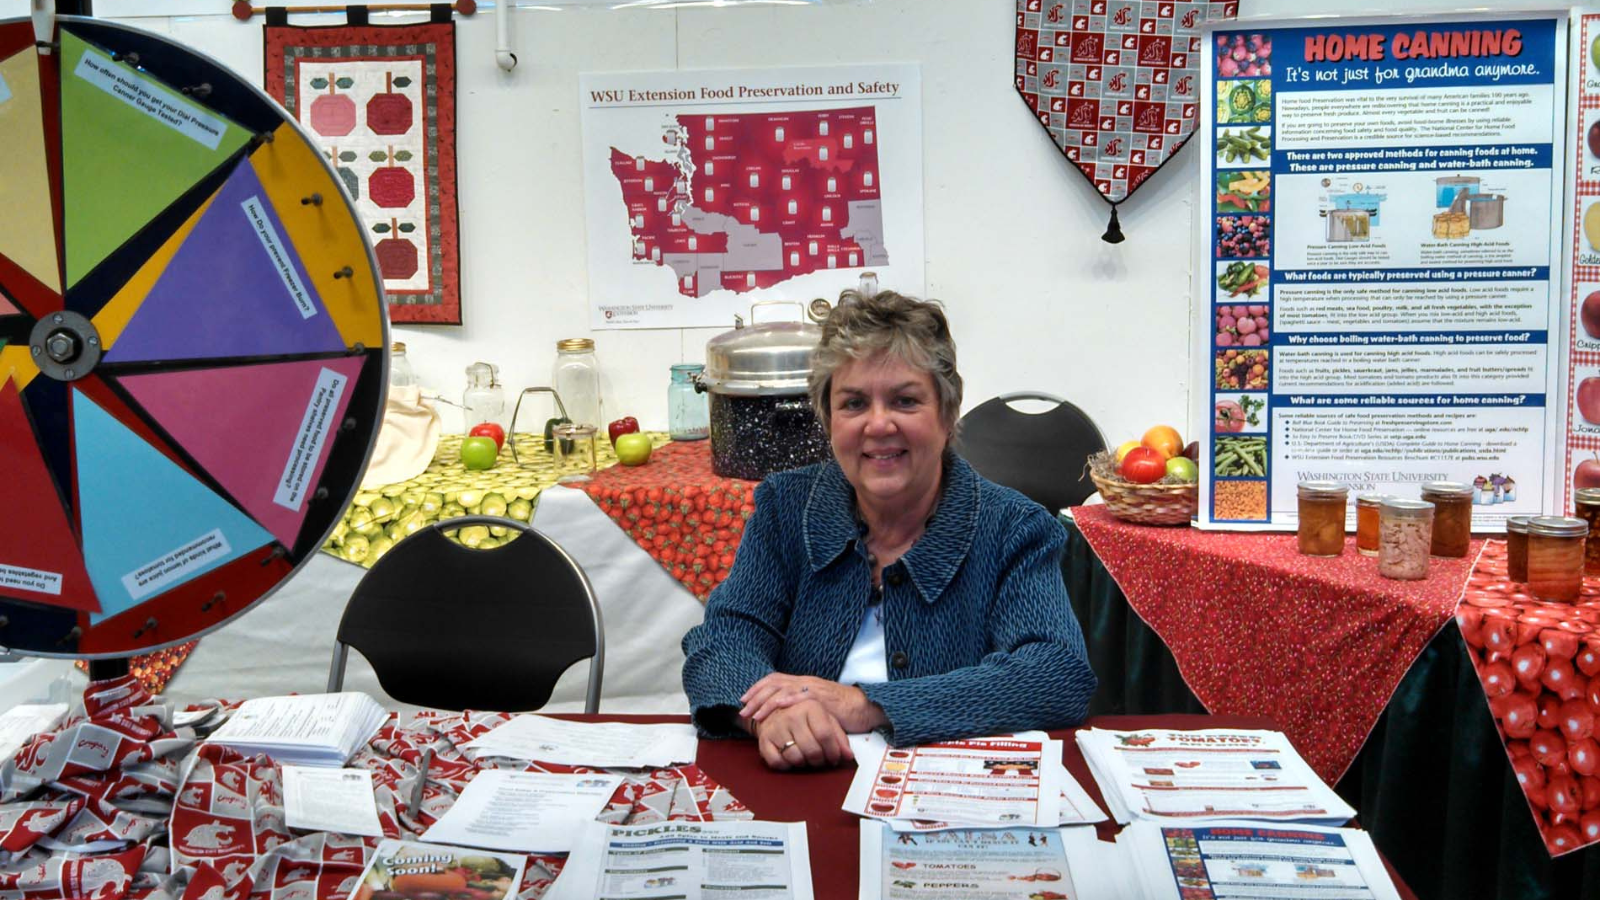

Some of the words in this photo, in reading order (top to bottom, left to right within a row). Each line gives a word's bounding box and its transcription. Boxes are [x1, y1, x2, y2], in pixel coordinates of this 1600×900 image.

[1304, 34, 1385, 62] HOME
[1391, 29, 1523, 60] CANNING
[1286, 67, 1310, 83] It's
[1315, 67, 1338, 82] not
[1341, 67, 1369, 85] just
[1375, 65, 1400, 84] for
[1404, 62, 1469, 84] grandma
[1474, 62, 1540, 81] anymore.
[83, 58, 100, 71] How
[98, 66, 117, 80] often
[115, 75, 140, 92] should
[136, 88, 152, 100] you
[149, 95, 163, 107] get
[160, 102, 177, 115] your
[176, 109, 191, 121] Dial
[189, 116, 220, 136] Pressure
[590, 90, 624, 102] WSU
[628, 88, 695, 101] Extension
[700, 86, 734, 98] Food
[738, 84, 822, 97] Preservation
[827, 82, 853, 94] and
[857, 81, 898, 95] Safety
[111, 83, 137, 101] Canner
[134, 96, 158, 114] Gauge
[156, 108, 183, 127] Tested?
[1286, 151, 1310, 160] There
[1326, 151, 1343, 159] two
[1344, 149, 1384, 160] approved
[1384, 148, 1423, 157] methods
[1424, 148, 1437, 156] for
[1439, 147, 1473, 158] canning
[1474, 146, 1499, 155] foods
[1510, 145, 1537, 154] home.
[1289, 162, 1317, 171] These
[1335, 163, 1376, 171] pressure
[1377, 160, 1416, 170] canning
[1418, 159, 1437, 168] and
[1438, 158, 1491, 168] water-bath
[1492, 158, 1533, 167] canning.
[247, 204, 260, 220] How
[255, 218, 266, 230] Do
[259, 228, 272, 245] your
[268, 243, 286, 269] prevent
[282, 266, 299, 292] Freezer
[1284, 271, 1306, 280] What
[1307, 271, 1331, 279] foods
[1348, 270, 1385, 280] typically
[1386, 270, 1430, 279] preserved
[1431, 270, 1455, 279] using
[1463, 270, 1500, 278] pressure
[1501, 267, 1536, 276] canner?
[294, 290, 310, 312] Burn?
[1288, 335, 1307, 344] Why
[1308, 334, 1338, 342] choose
[1339, 334, 1369, 344] boiling
[1370, 334, 1418, 342] water-bath
[1419, 334, 1454, 343] canning
[1504, 332, 1530, 341] food?
[330, 378, 340, 390] Do
[312, 386, 327, 408] Pantry
[327, 388, 335, 398] all
[1290, 396, 1315, 404] What
[1452, 395, 1479, 403] home
[1481, 394, 1525, 404] canning?
[304, 407, 318, 433] shelves
[315, 397, 332, 430] preserved
[298, 432, 309, 450] need
[310, 428, 321, 445] food
[307, 443, 315, 452] to
[304, 451, 312, 462] be
[283, 448, 304, 488] processing?
[296, 460, 308, 483] stored
[1297, 471, 1361, 480] WASHINGTON
[1363, 471, 1390, 482] STATE
[1391, 471, 1449, 482] UNIVERSITY
[292, 480, 300, 491] on
[288, 490, 298, 503] the
[172, 534, 216, 559] recommended
[204, 540, 223, 553] What
[164, 555, 175, 564] for
[180, 557, 190, 565] of
[188, 548, 207, 561] kinds
[133, 560, 166, 580] tomatoes?
[162, 560, 182, 574] lemon
[8, 569, 41, 579] vegetables
[44, 574, 56, 582] And
[147, 569, 164, 581] juice
[137, 578, 148, 587] are
[611, 825, 702, 837] PICKLES
[382, 854, 453, 865] Coming
[386, 864, 437, 876] Soon!
